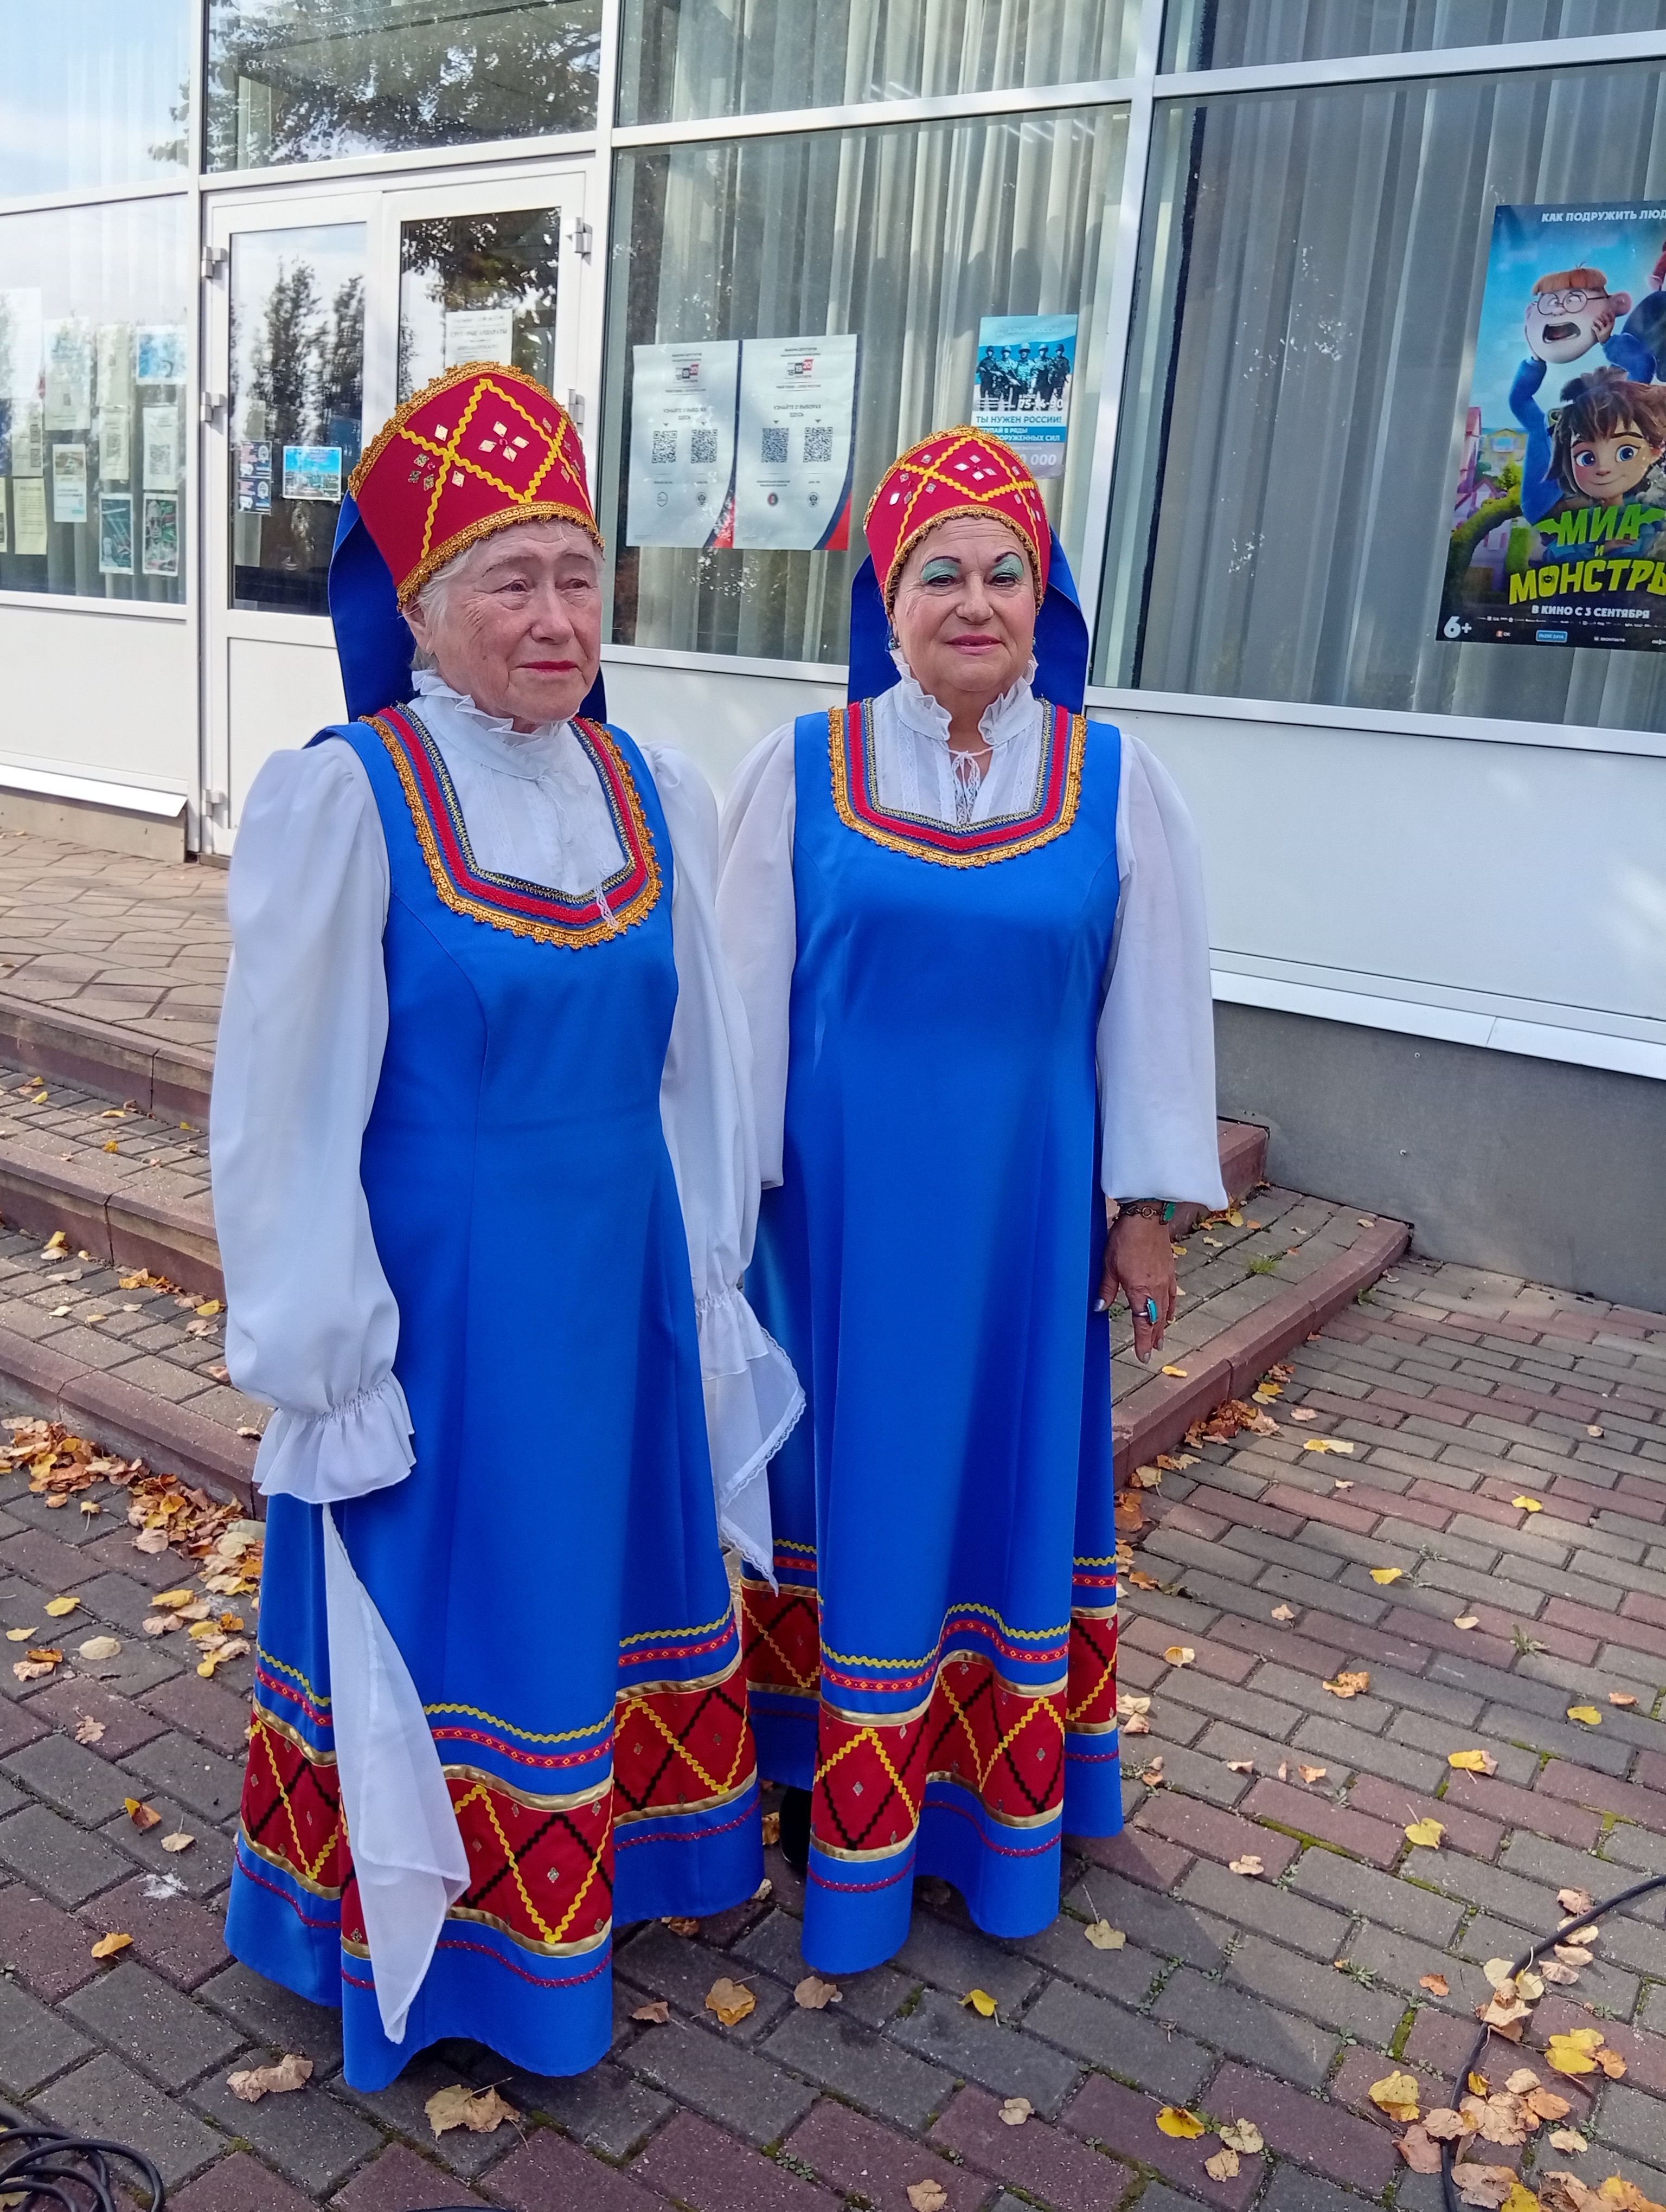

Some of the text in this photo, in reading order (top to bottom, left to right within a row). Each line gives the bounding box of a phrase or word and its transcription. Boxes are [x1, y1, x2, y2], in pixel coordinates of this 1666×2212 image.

[1541, 213, 1564, 222] КАК
[1566, 210, 1637, 222] ПОДРУЖИТЬ
[1030, 454, 1057, 466] 000
[1555, 503, 1643, 548] МИА
[1594, 545, 1605, 557] И
[1531, 605, 1539, 614] В
[1541, 605, 1573, 616] КИНО
[1574, 607, 1584, 616] С
[1593, 607, 1650, 619] СЕНТЯБРЯ
[1444, 616, 1472, 639] 6+
